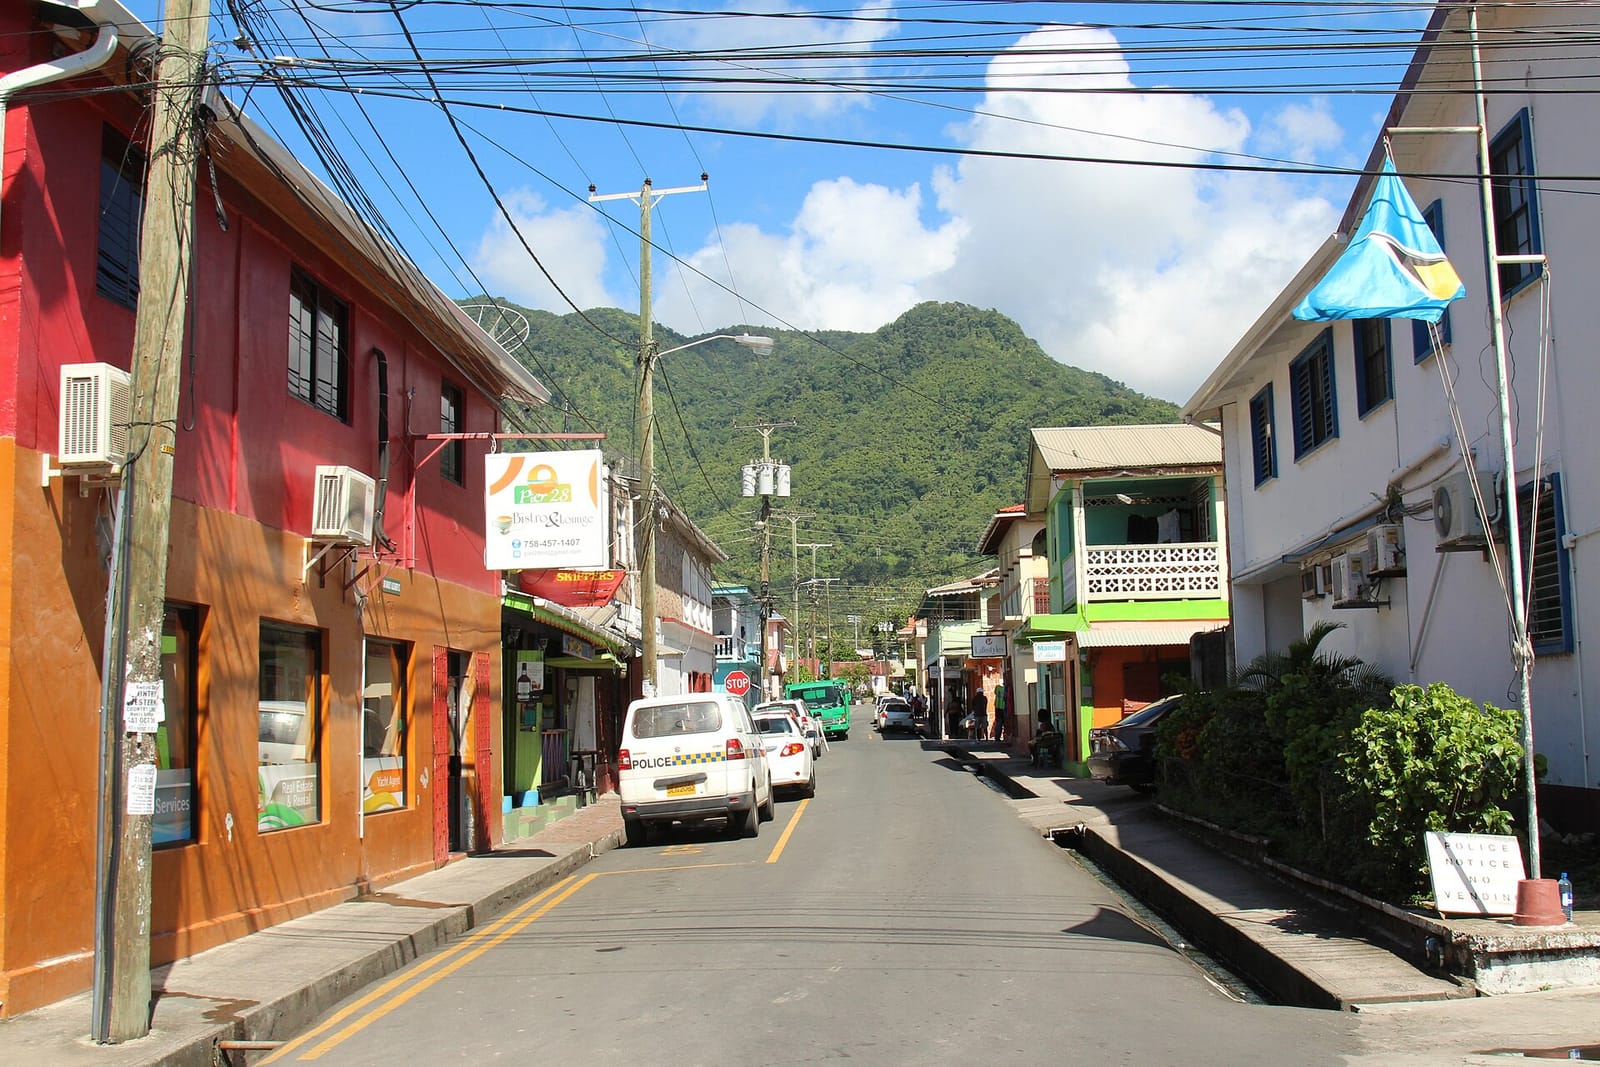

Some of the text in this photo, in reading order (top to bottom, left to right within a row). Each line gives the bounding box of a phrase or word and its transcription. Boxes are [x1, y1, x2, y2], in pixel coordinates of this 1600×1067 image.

[519, 487, 570, 504] Pier 28
[524, 538, 581, 548] 758-457-1407
[726, 678, 748, 688] STOP
[632, 757, 672, 769] POLICE
[282, 780, 313, 793] Real Estate
[155, 797, 190, 814] Services
[294, 793, 311, 807] Rental
[1444, 841, 1509, 852] POLICE
[1445, 858, 1510, 868] NOTICE
[1469, 876, 1490, 884] NO
[1444, 890, 1516, 901] VENDIN
